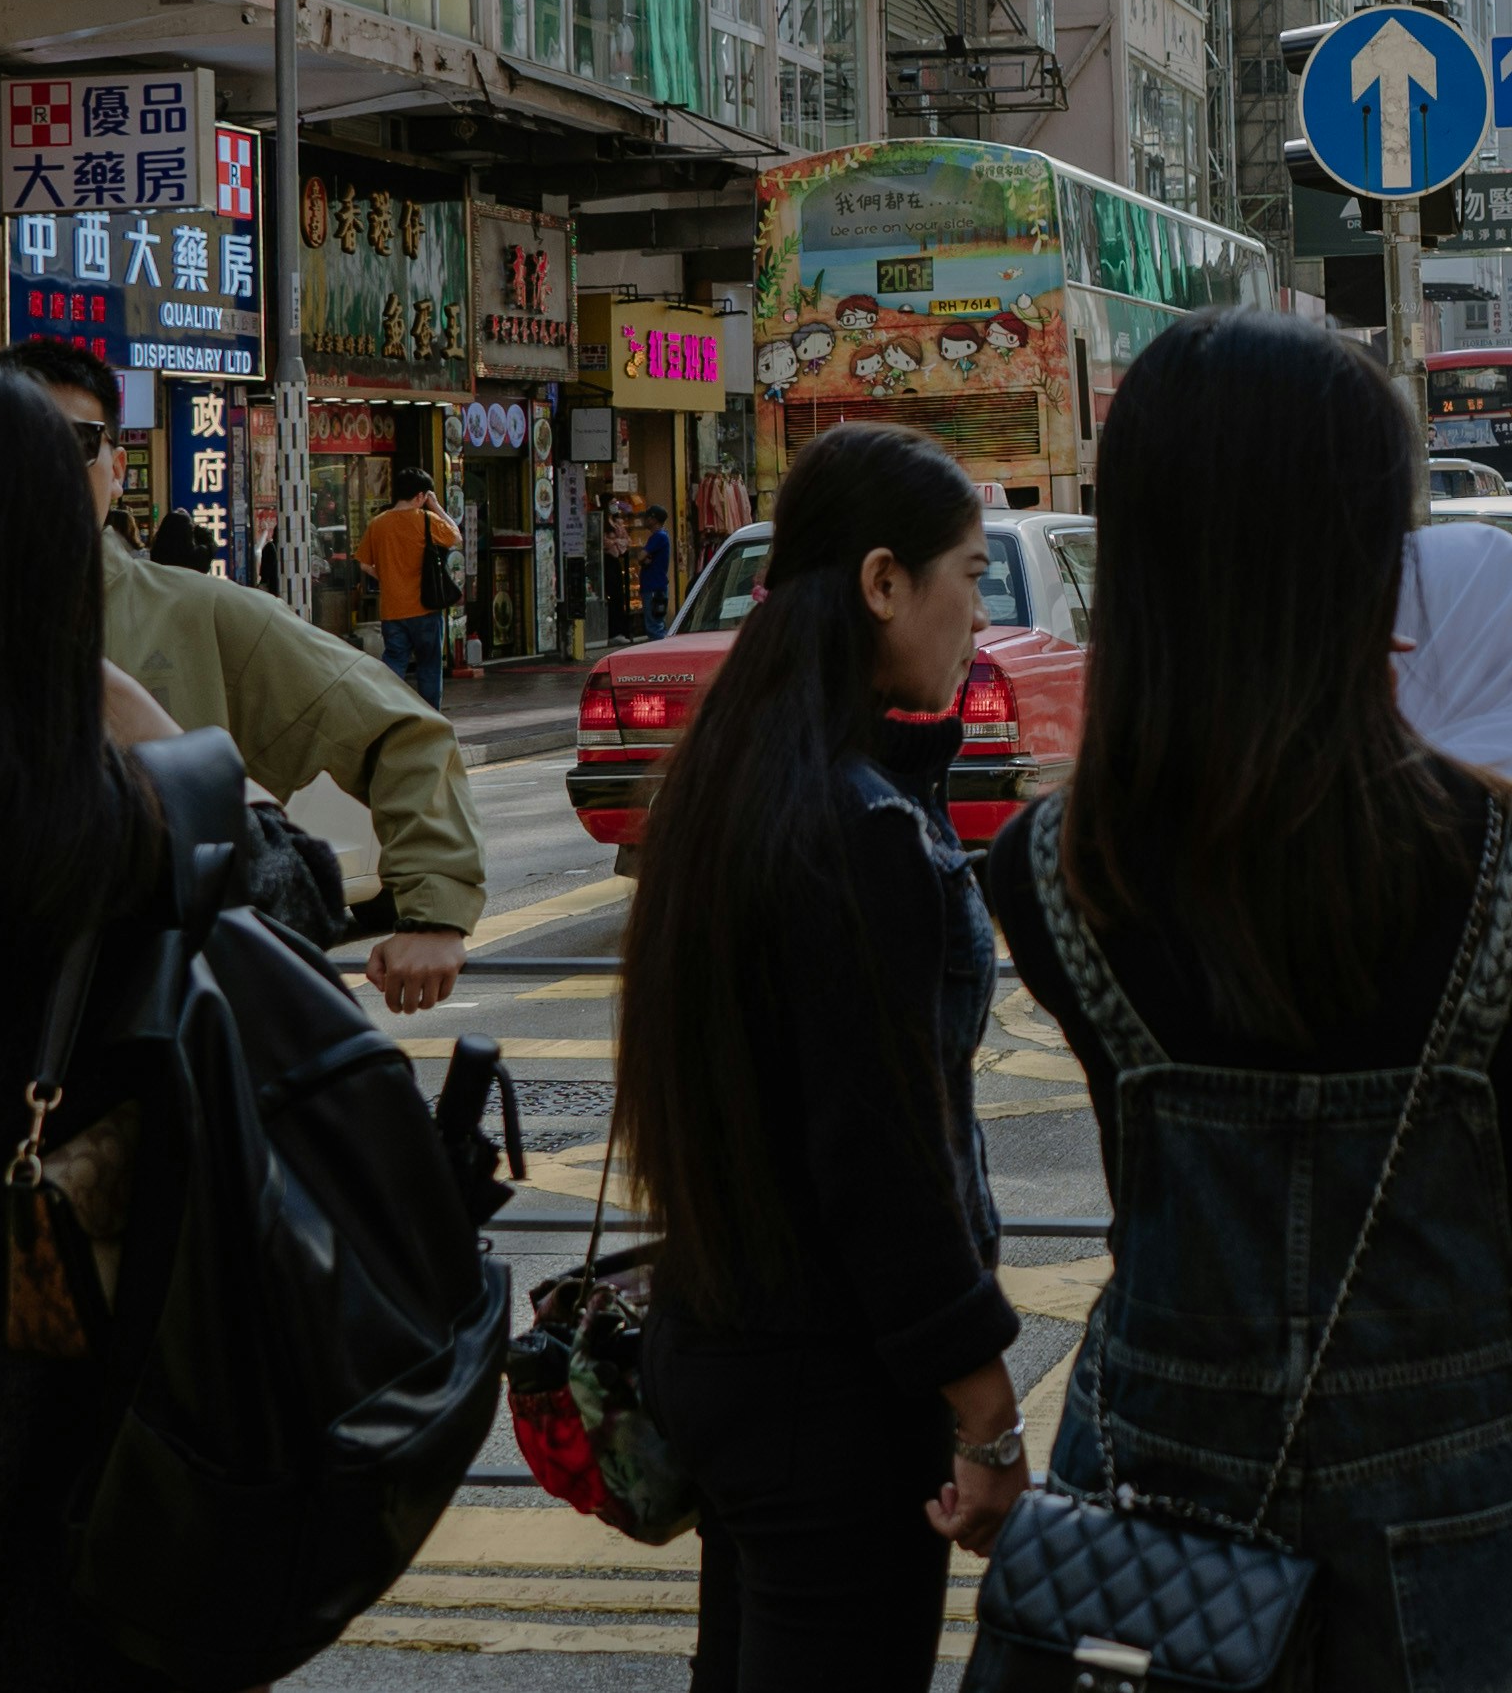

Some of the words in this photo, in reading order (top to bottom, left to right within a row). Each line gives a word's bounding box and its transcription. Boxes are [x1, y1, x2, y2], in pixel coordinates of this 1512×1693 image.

[82, 83, 187, 137] 優品
[13, 147, 187, 208] 大藥房
[830, 225, 850, 236] We
[855, 224, 878, 235] are
[883, 223, 901, 234] on
[906, 221, 937, 238] your
[943, 218, 974, 229] side
[18, 211, 254, 297] 中西大藥房
[880, 263, 932, 292] 203E
[160, 301, 224, 331] QUALITY
[938, 300, 959, 312] RH
[962, 298, 992, 310] 7614
[130, 341, 222, 372] DISPENSARY
[224, 349, 252, 375] LTD
